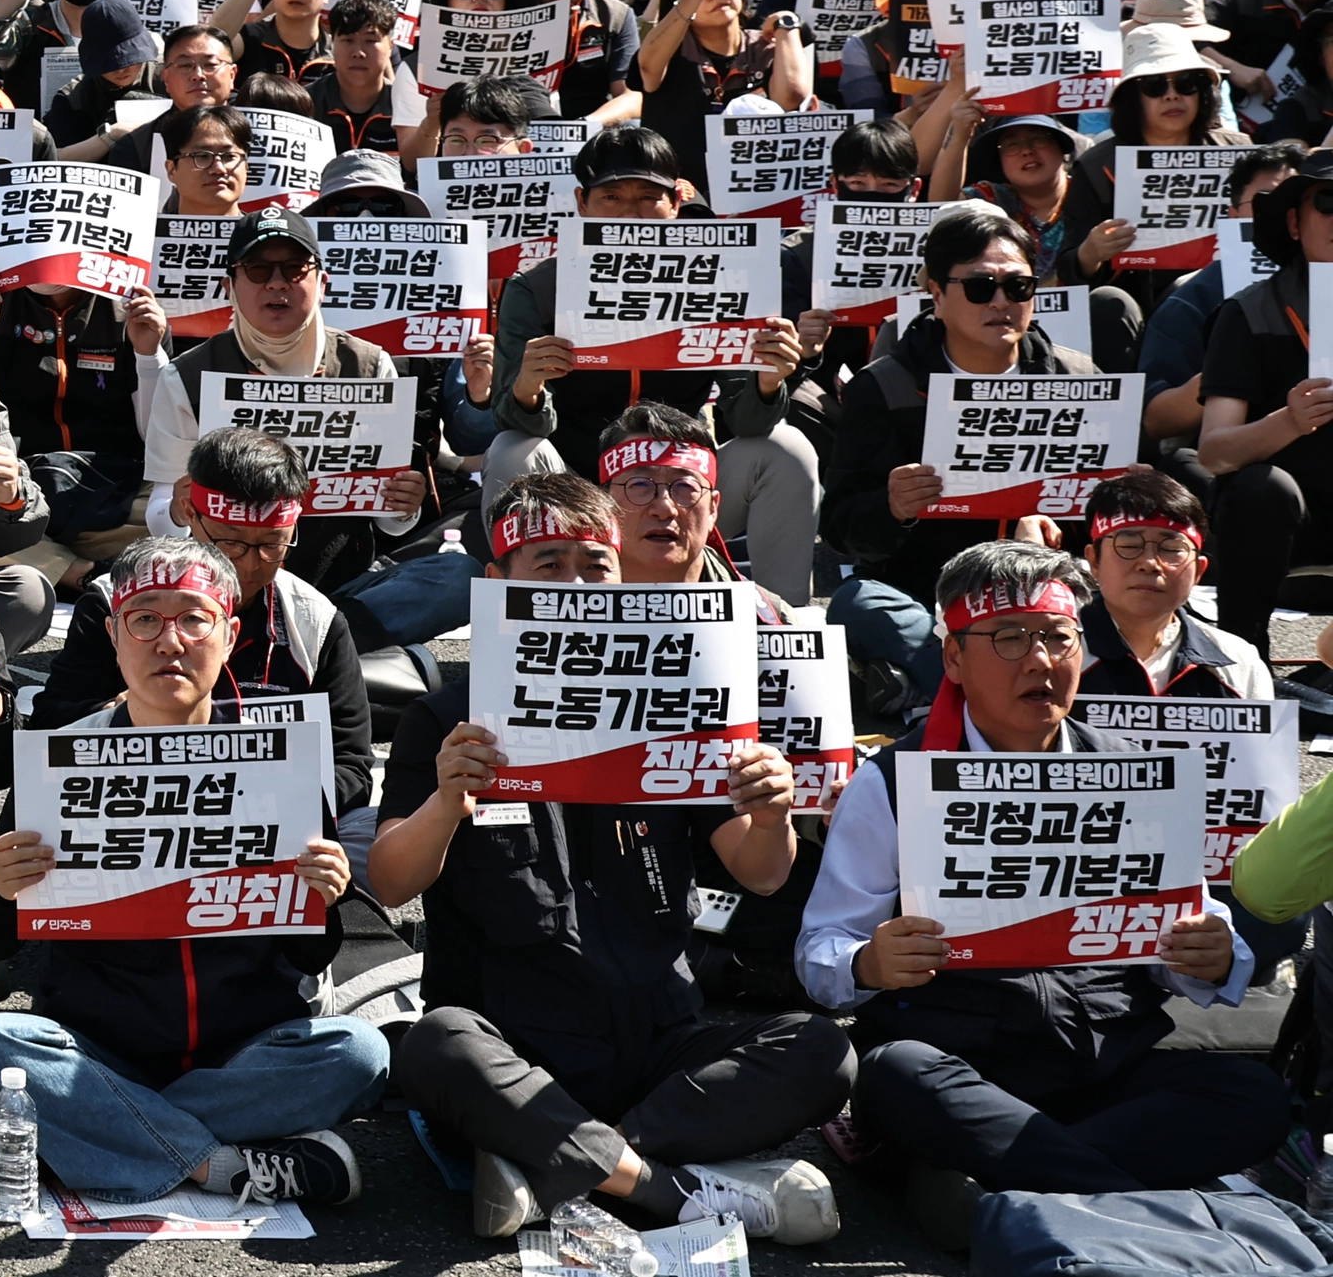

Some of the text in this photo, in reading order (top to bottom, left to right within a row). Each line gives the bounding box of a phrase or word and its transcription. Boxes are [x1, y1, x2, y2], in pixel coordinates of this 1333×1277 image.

[604, 442, 636, 476] 단결
[532, 591, 733, 622] 열사의 염원이다!
[507, 686, 736, 731] 노동기본권
[74, 733, 274, 765] 열사의 염원이다!
[640, 740, 764, 794] 쟁취
[961, 761, 1164, 791] 열사의 염원이다!
[54, 825, 279, 870] 노동기본권
[937, 854, 1166, 898] 노동기본권
[186, 874, 309, 928] 쟁취!
[49, 920, 91, 930] 민주노총
